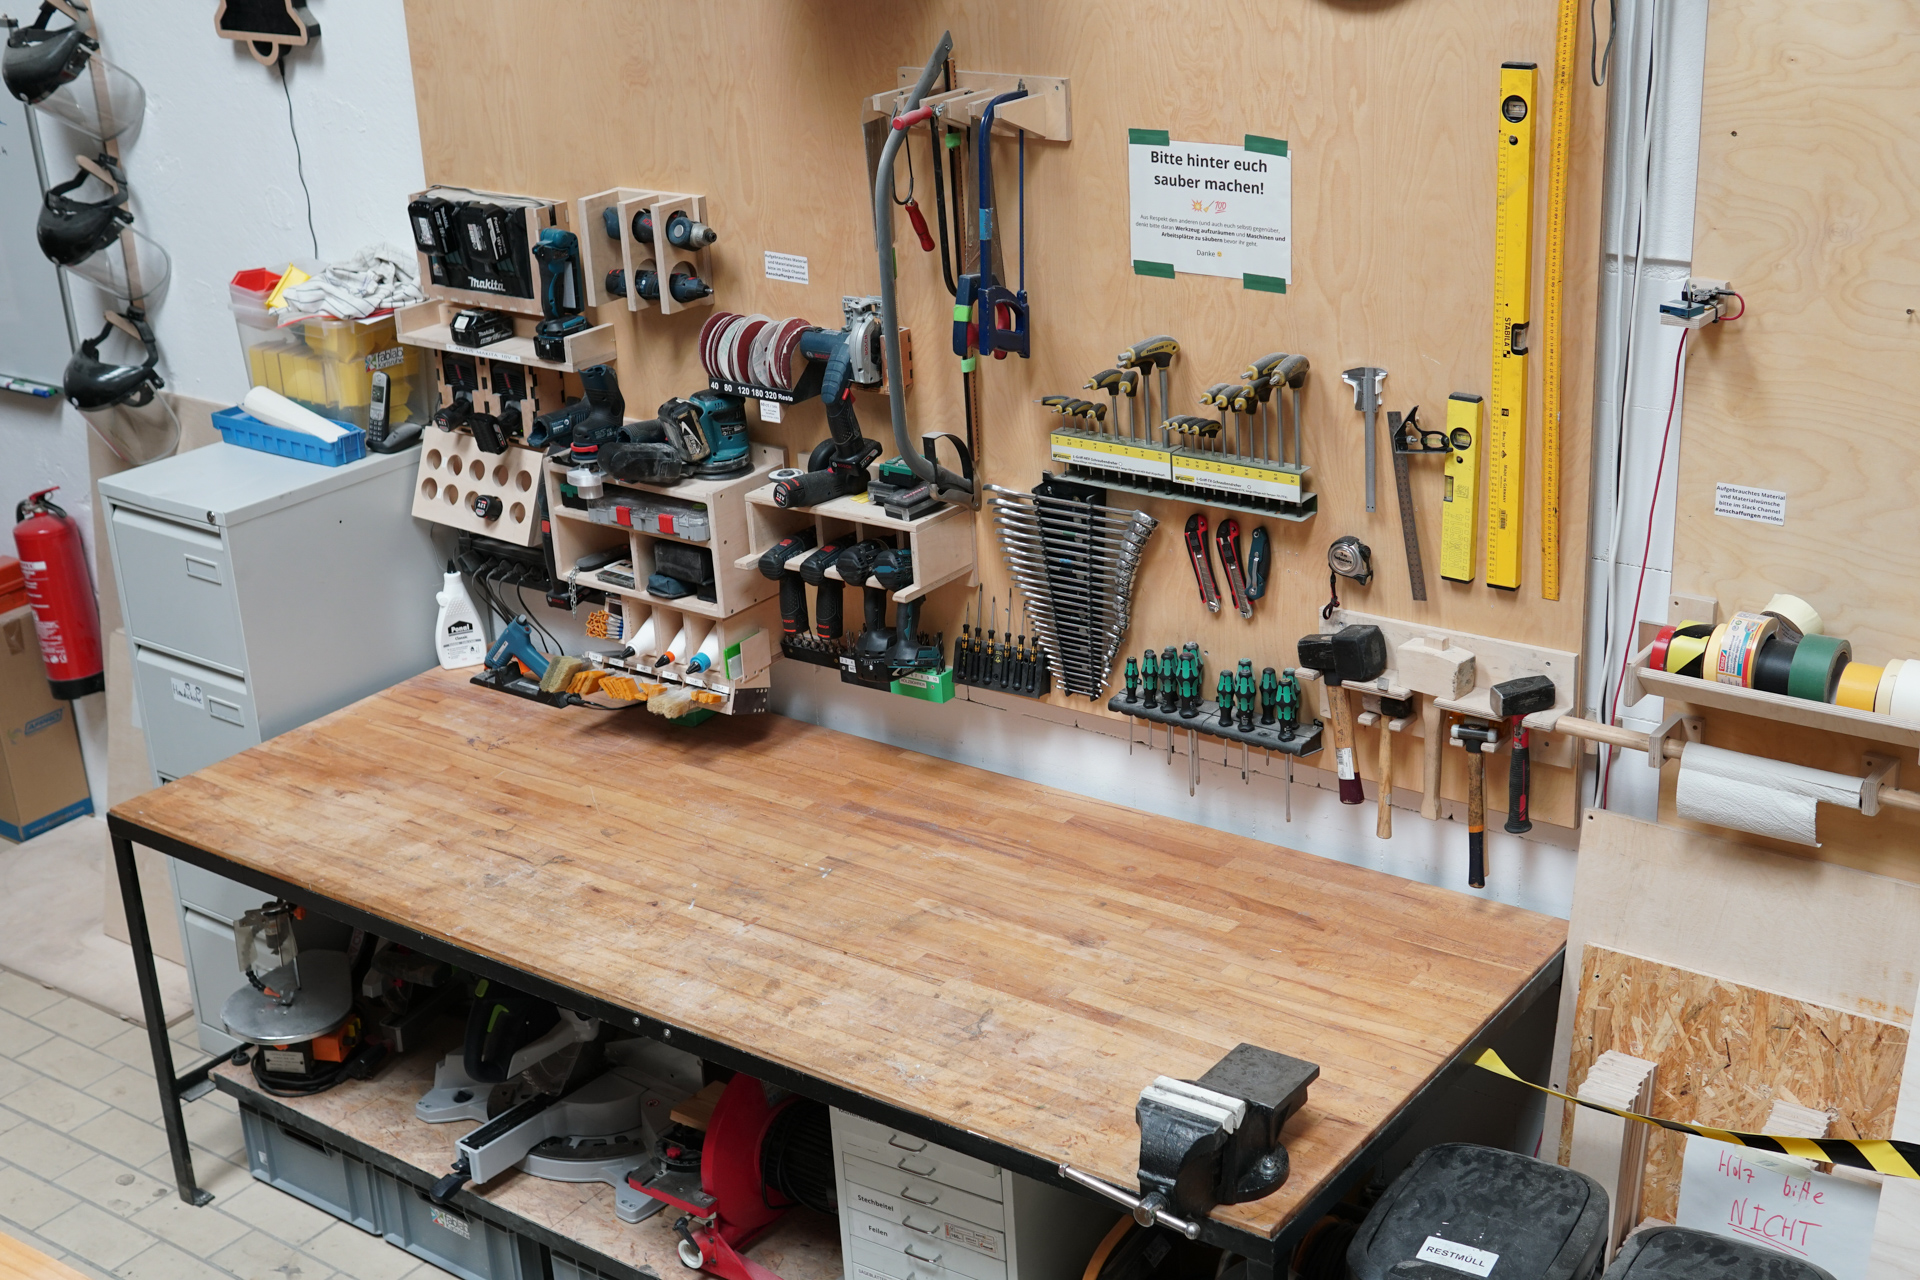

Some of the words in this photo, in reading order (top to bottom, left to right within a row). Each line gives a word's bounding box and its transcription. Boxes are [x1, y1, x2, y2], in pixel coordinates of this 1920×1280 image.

[1151, 150, 1183, 166] Bitte
[1187, 154, 1230, 170] hinter
[1234, 159, 1267, 173] euch
[1154, 174, 1200, 188] sauber
[1204, 178, 1264, 195] machen!
[1162, 232, 1194, 240] Arbeitsplätze
[1201, 228, 1235, 236] aufzuräumen
[468, 276, 506, 291] makita
[378, 347, 403, 362] fablab
[711, 381, 719, 390] 40
[724, 384, 732, 392] 80
[738, 386, 749, 395] 120
[752, 389, 763, 397] 180
[765, 391, 777, 400] 320
[1717, 486, 1760, 496] Aufgebrauchtes
[1732, 496, 1780, 507] Materialwünsche
[1715, 507, 1761, 518] #anschaffungen
[451, 624, 470, 633] Ponal
[1718, 1150, 1755, 1183] Holz
[1784, 1175, 1825, 1204] bitte
[858, 1195, 894, 1212] Stechbeitel
[1731, 1198, 1822, 1246] NICHT
[869, 1225, 888, 1237] Feilen
[1426, 1246, 1485, 1267] RESTMÜLL
